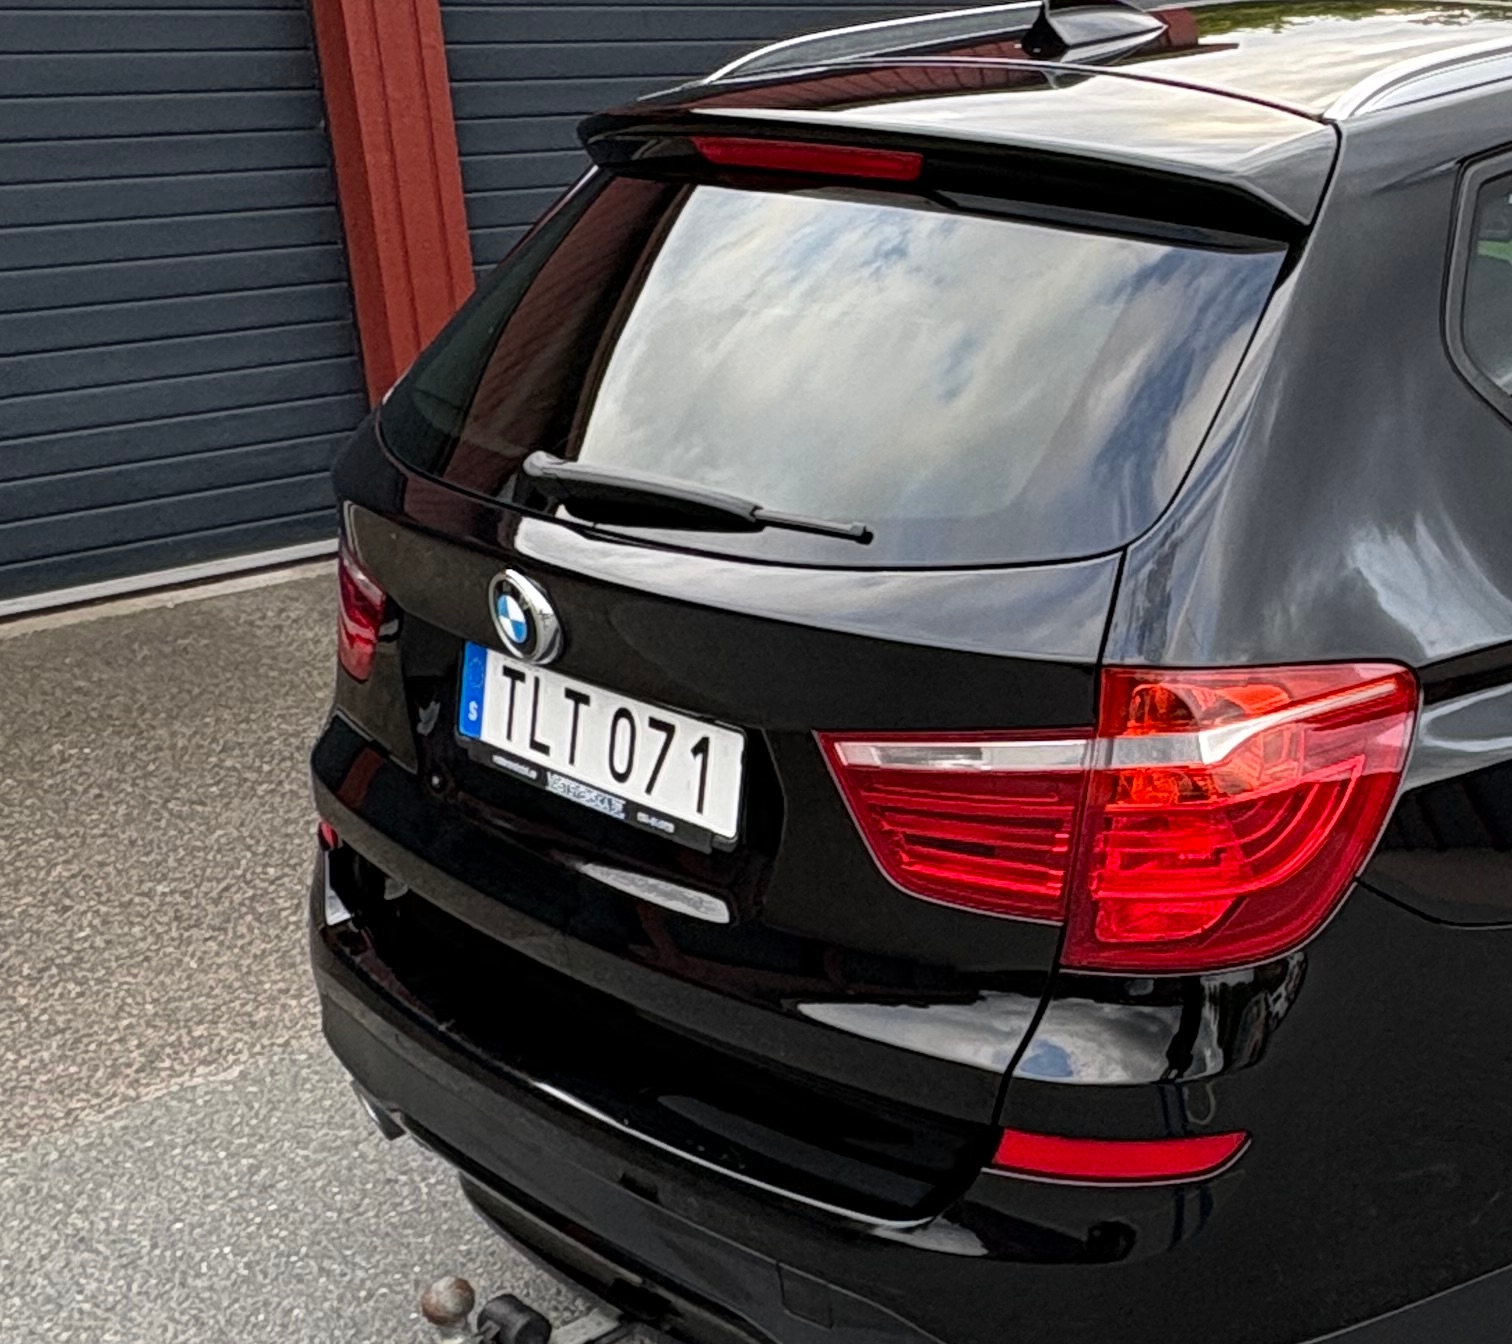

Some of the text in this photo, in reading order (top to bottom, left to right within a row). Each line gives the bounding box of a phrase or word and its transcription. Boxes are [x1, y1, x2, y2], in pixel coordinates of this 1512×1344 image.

[467, 700, 479, 722] S
[502, 665, 591, 767] TLT
[608, 706, 710, 816] 071
